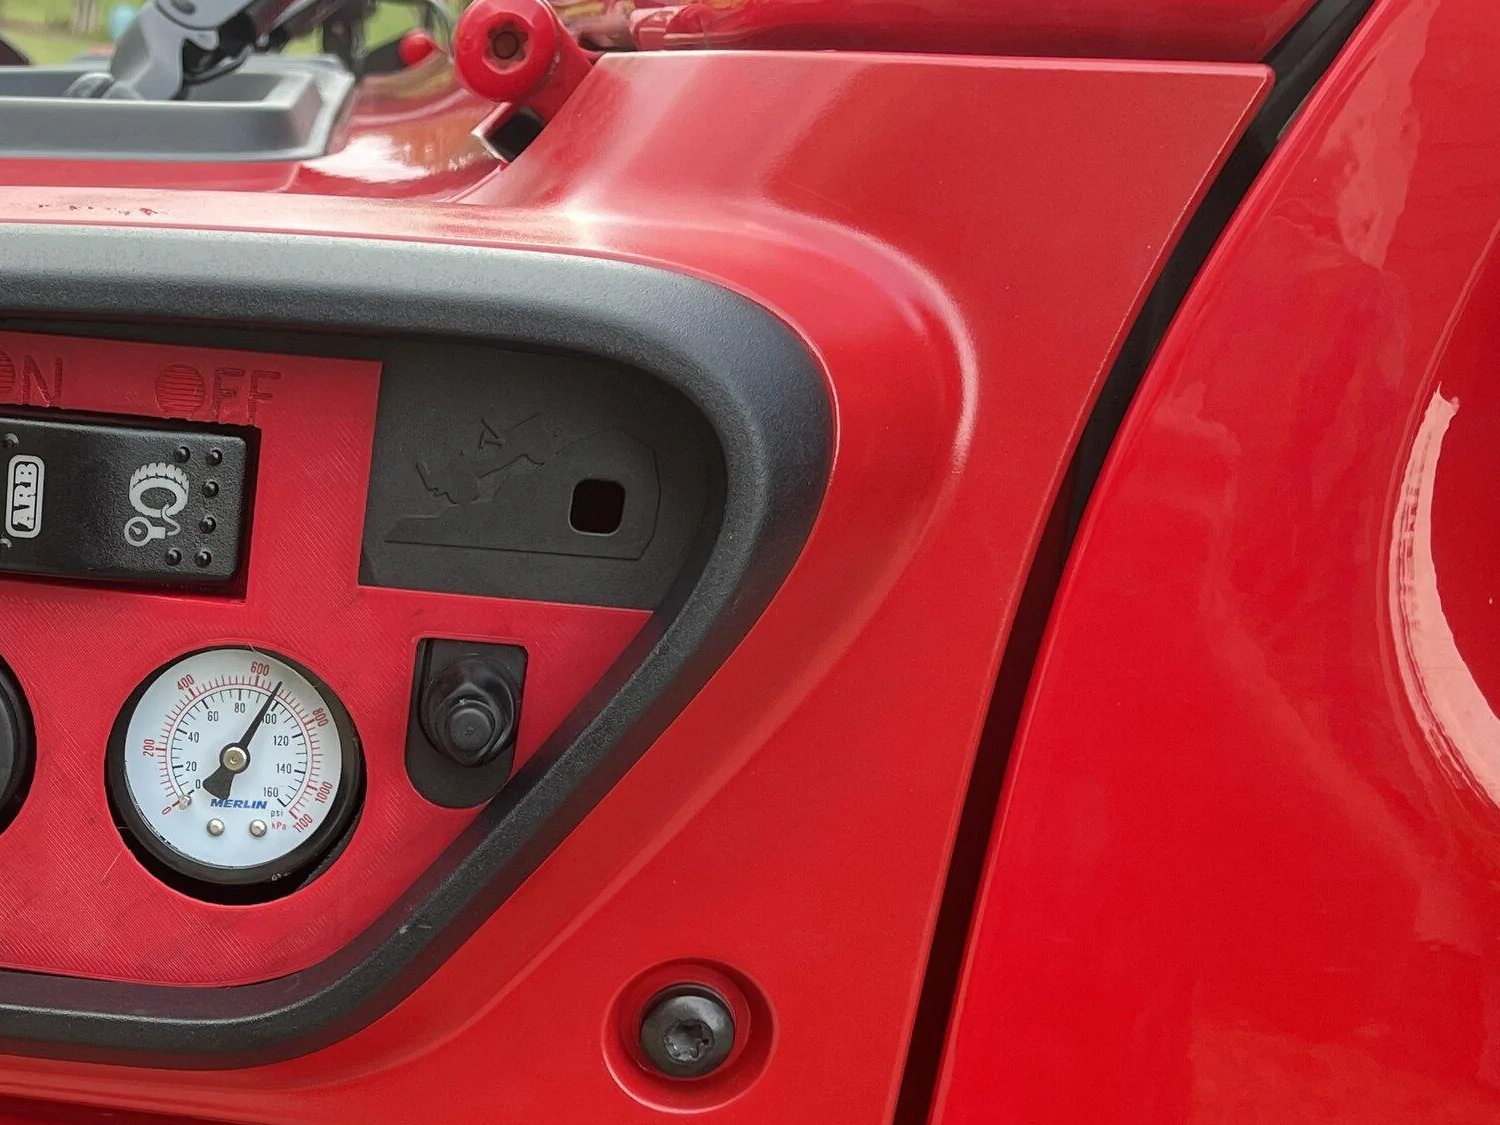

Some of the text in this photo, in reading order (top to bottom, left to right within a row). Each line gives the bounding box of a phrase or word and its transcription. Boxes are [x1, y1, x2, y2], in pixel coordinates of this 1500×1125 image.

[12, 461, 39, 530] ARB
[250, 661, 270, 677] 600
[177, 673, 195, 691] 400
[234, 702, 246, 714] 80
[207, 710, 219, 722] 60
[312, 707, 329, 727] 800
[187, 731, 200, 743] 40
[273, 735, 289, 746] 120
[143, 739, 155, 757] 200
[185, 761, 197, 772] 20
[276, 763, 292, 774] 140
[195, 779, 201, 790] 0
[263, 786, 279, 798] 160
[314, 781, 333, 804] 1000
[210, 798, 268, 809] MERLIN
[270, 809, 284, 818] psi
[292, 813, 313, 833] 1100
